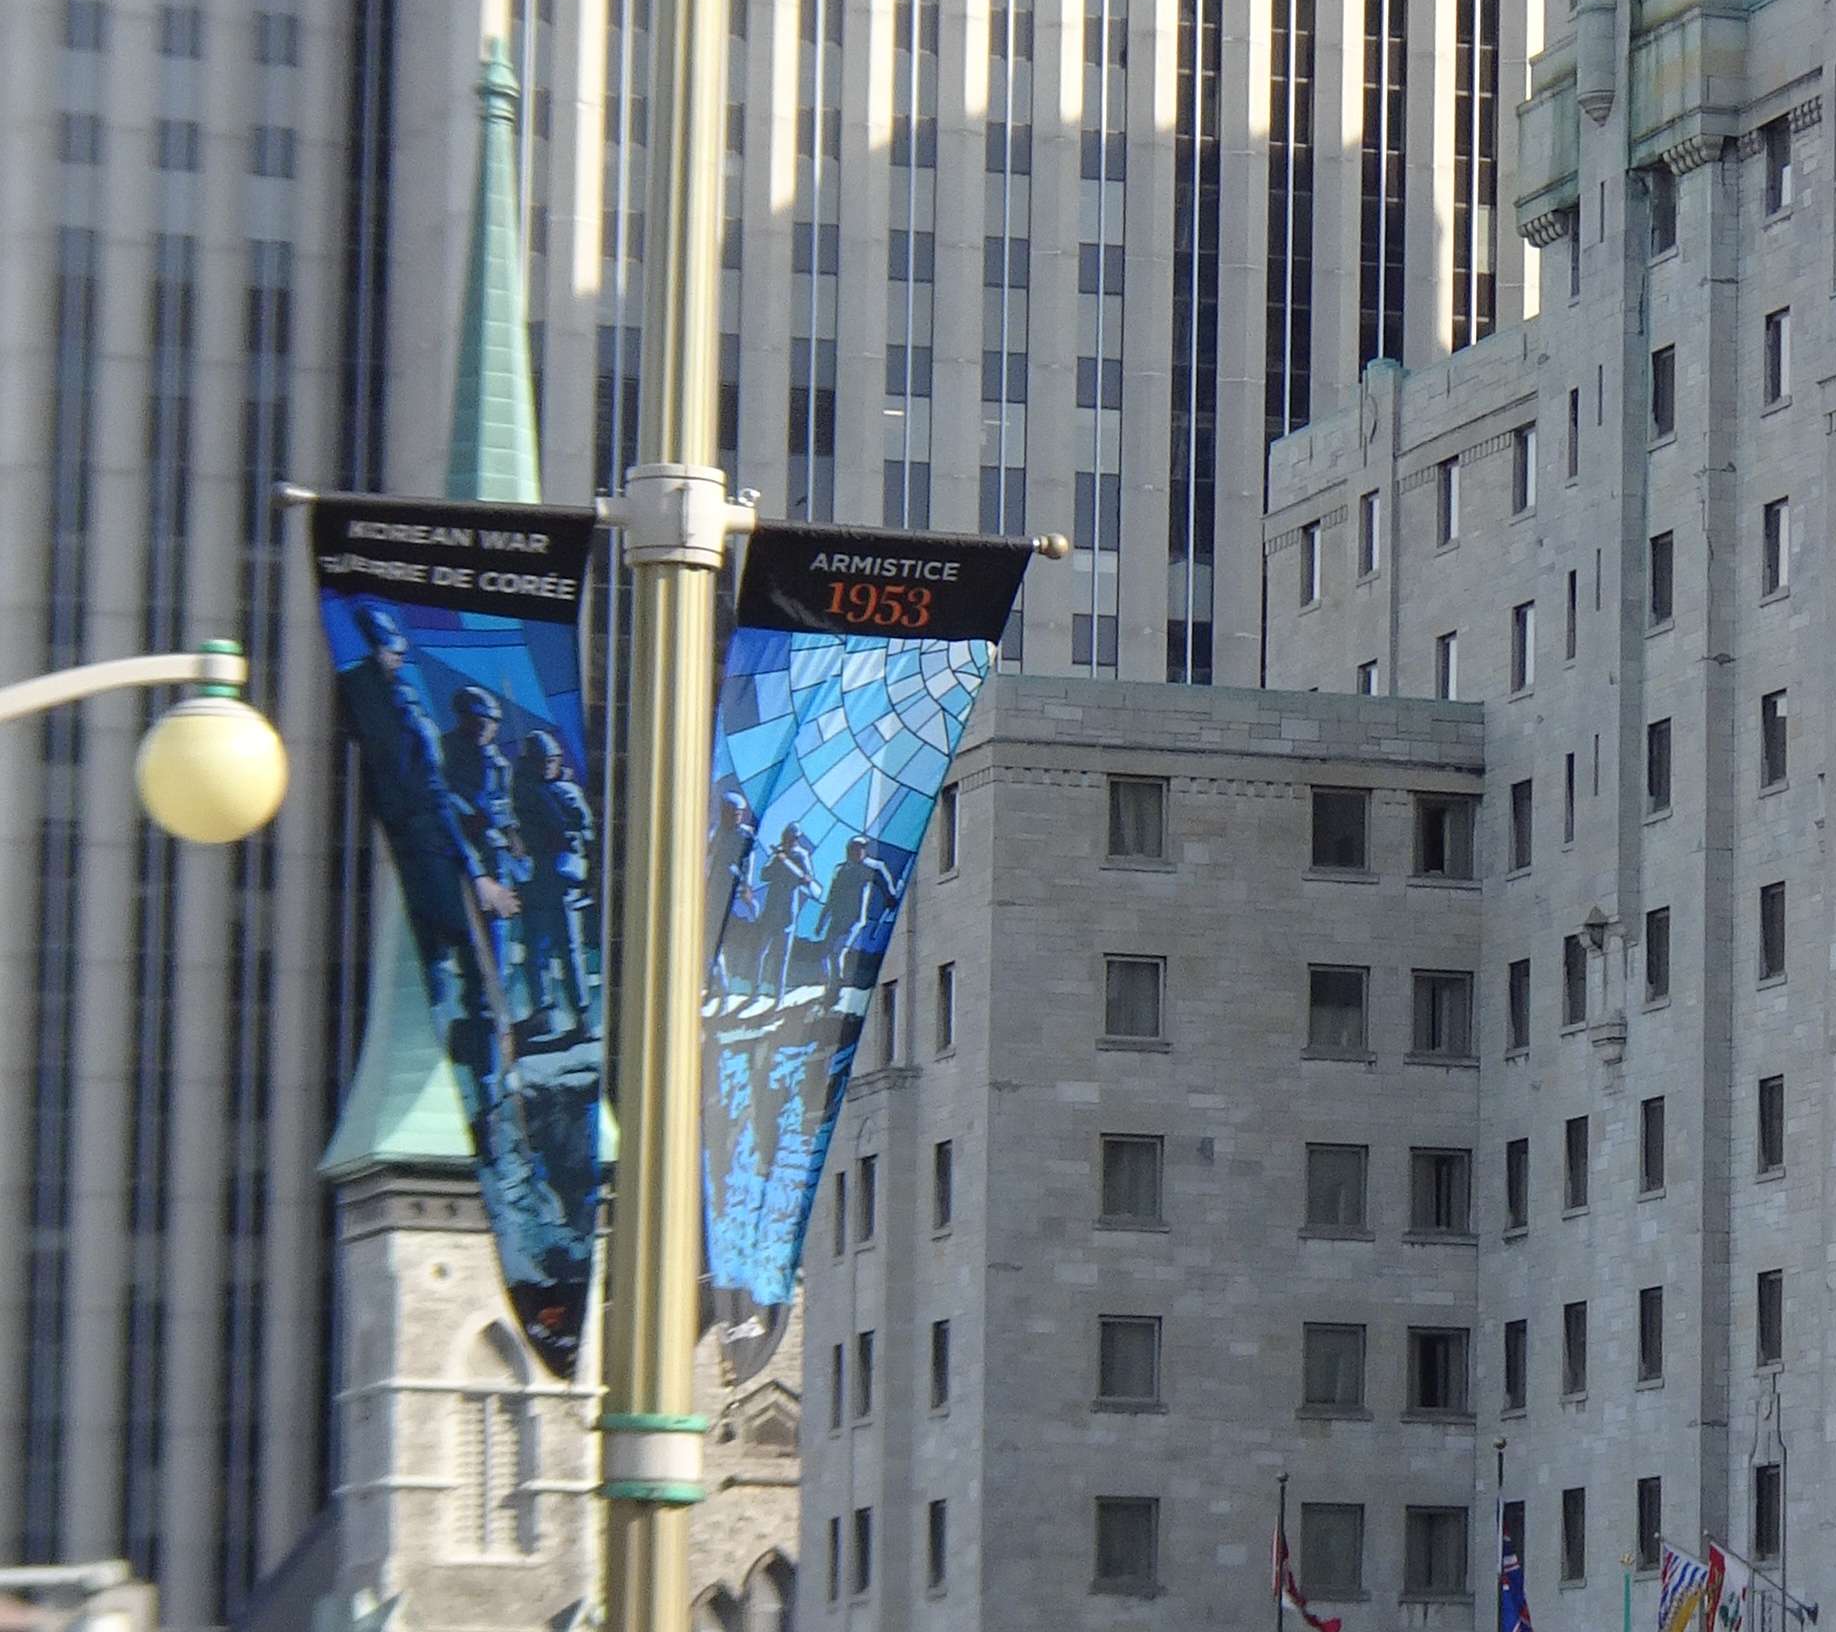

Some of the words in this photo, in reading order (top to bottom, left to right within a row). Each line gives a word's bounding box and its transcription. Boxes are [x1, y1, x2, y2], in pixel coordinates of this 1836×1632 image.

[349, 521, 473, 546] KOREAN
[478, 529, 550, 553] WAR
[431, 566, 475, 588] DE
[478, 572, 576, 600] CORÉE
[810, 553, 960, 581] ARMISTICE
[826, 581, 932, 628] 1953
